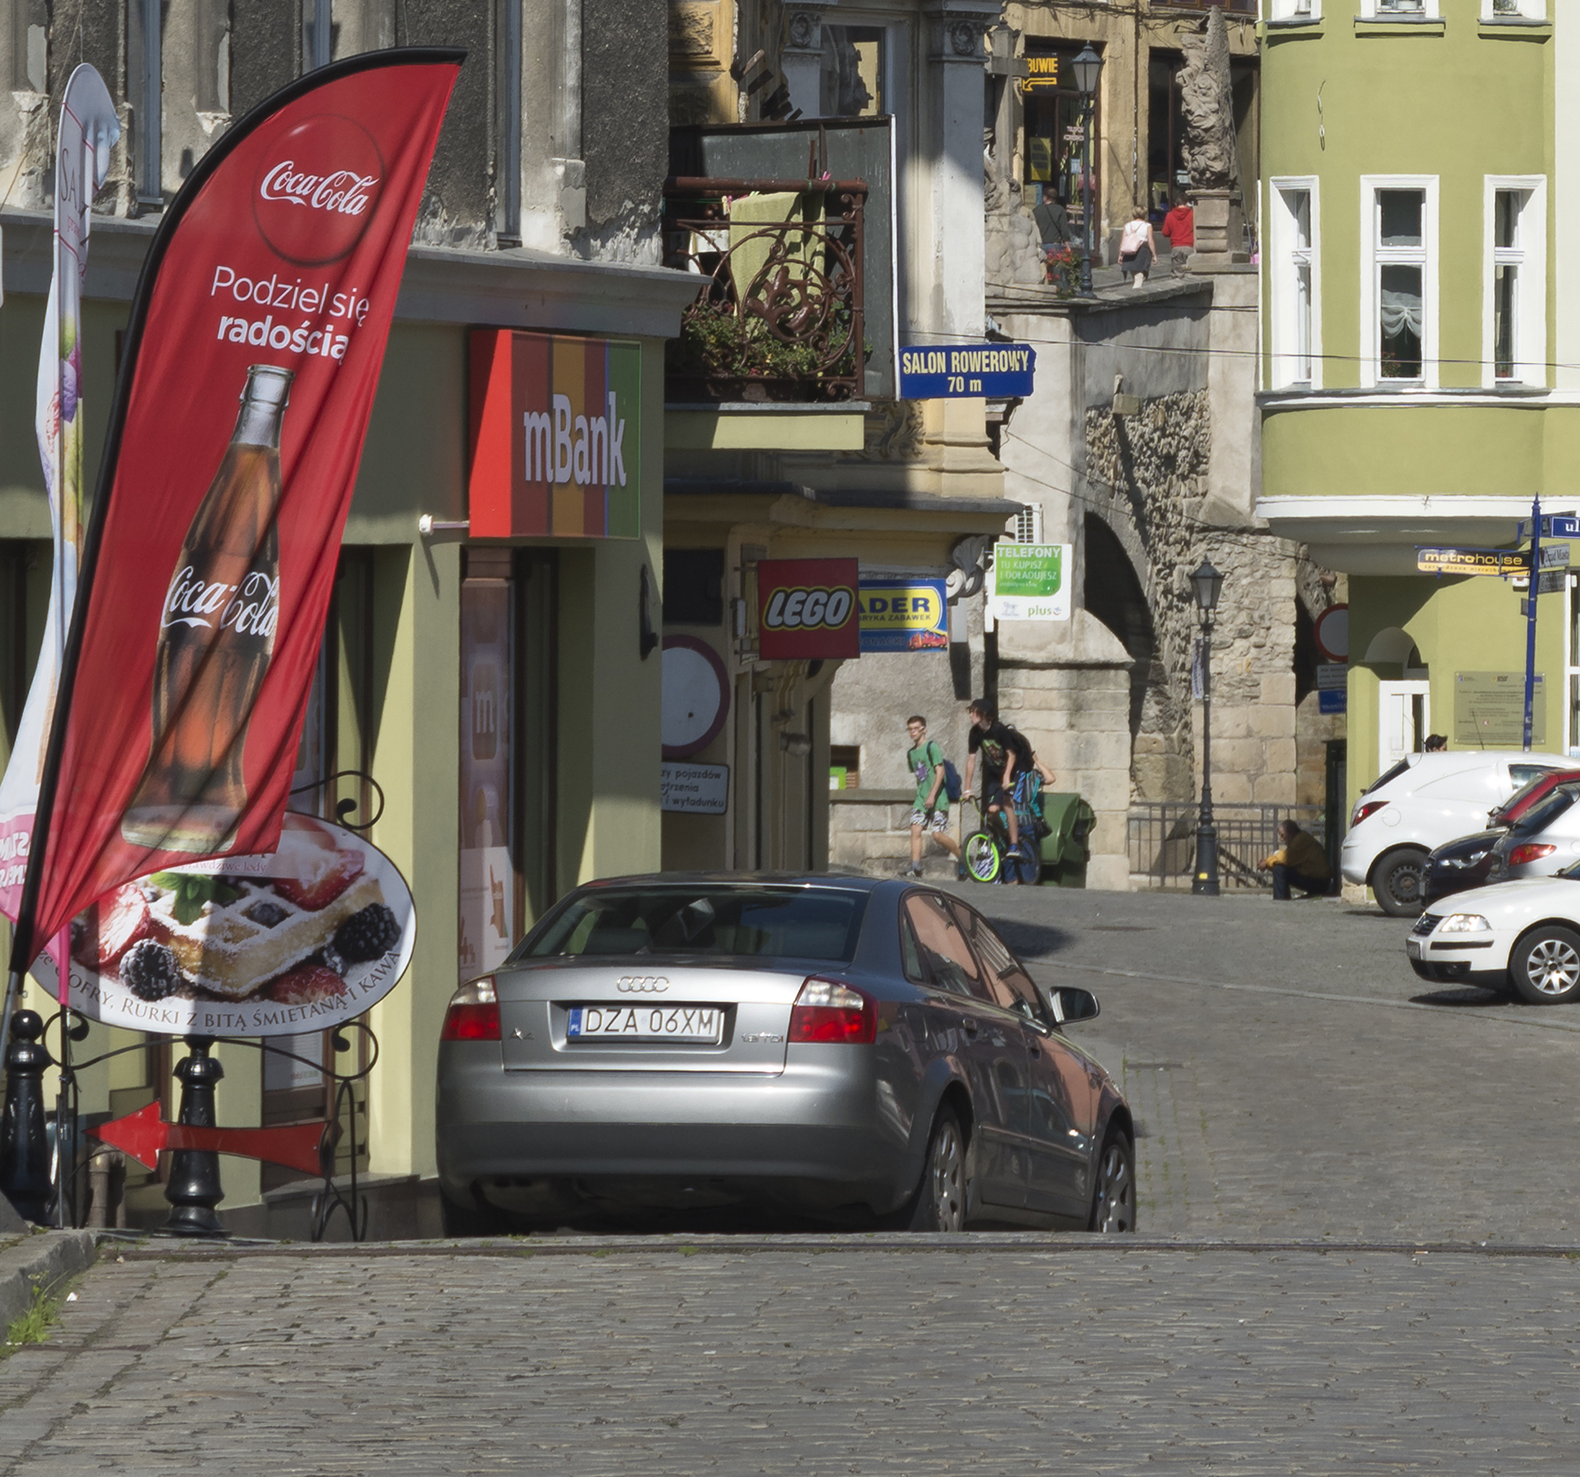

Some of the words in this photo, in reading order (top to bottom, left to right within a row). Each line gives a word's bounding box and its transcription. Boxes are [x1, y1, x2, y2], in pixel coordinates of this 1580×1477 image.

[1027, 58, 1058, 73] BUWIE
[260, 160, 379, 216] Coca-Cola
[211, 265, 329, 314] Podziel
[329, 287, 370, 327] się
[217, 315, 350, 365] radością
[903, 351, 946, 375] SALON
[951, 350, 1029, 373] ROWEROWY
[947, 376, 965, 393] 70
[969, 378, 982, 392] m
[524, 391, 627, 487] mBank
[997, 547, 1061, 558] TELEFONY
[1425, 552, 1523, 565] metrohouse
[767, 590, 851, 626] LEGO
[1028, 605, 1052, 617] plus
[675, 768, 721, 781] pojazdów
[121, 997, 180, 1025] RURKI
[204, 1012, 247, 1031] BITĄ
[252, 993, 348, 1027] ŚMIETANĄ
[585, 1009, 638, 1034] DZA
[650, 1009, 714, 1035] 06XM
